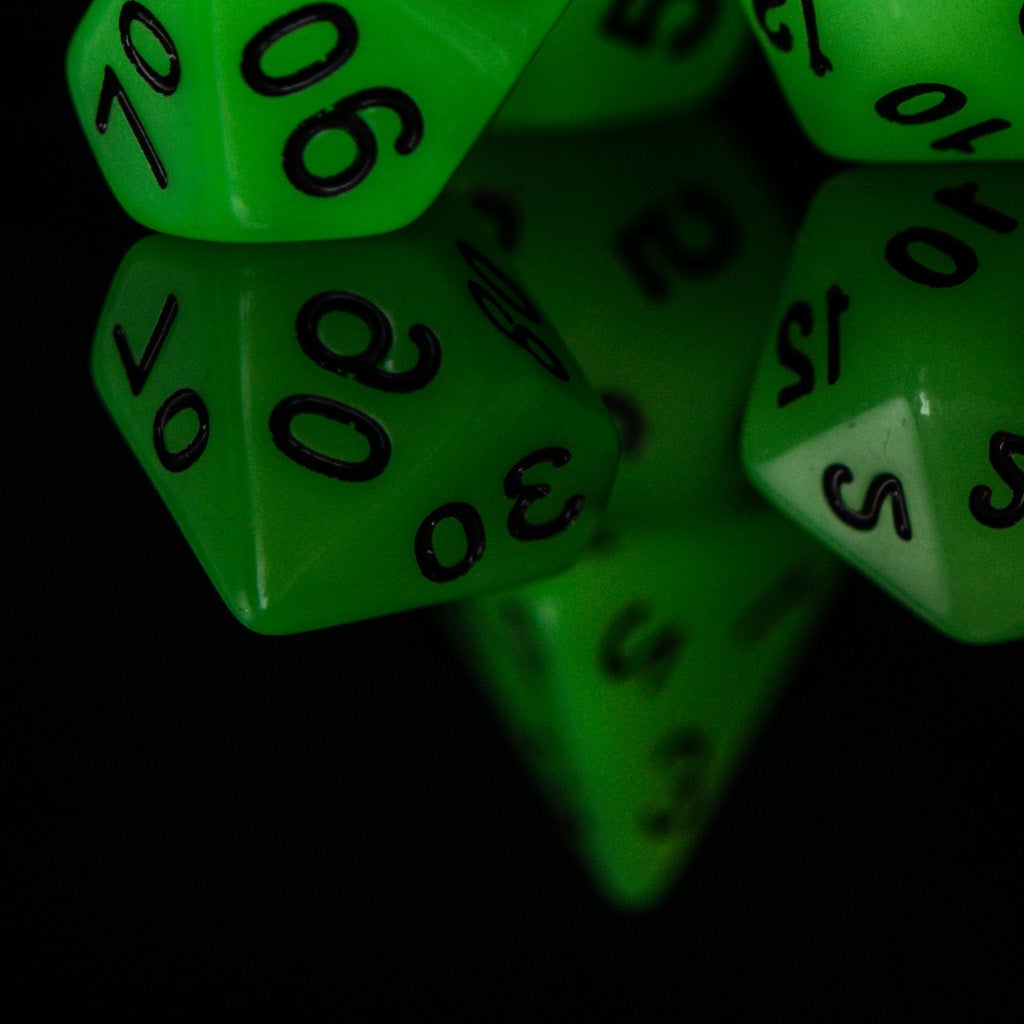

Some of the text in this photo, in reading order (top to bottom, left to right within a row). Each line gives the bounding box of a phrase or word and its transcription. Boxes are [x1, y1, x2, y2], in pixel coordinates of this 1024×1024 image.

[96, 0, 181, 189] 70
[241, 2, 424, 198] 90
[874, 82, 1013, 154] 10
